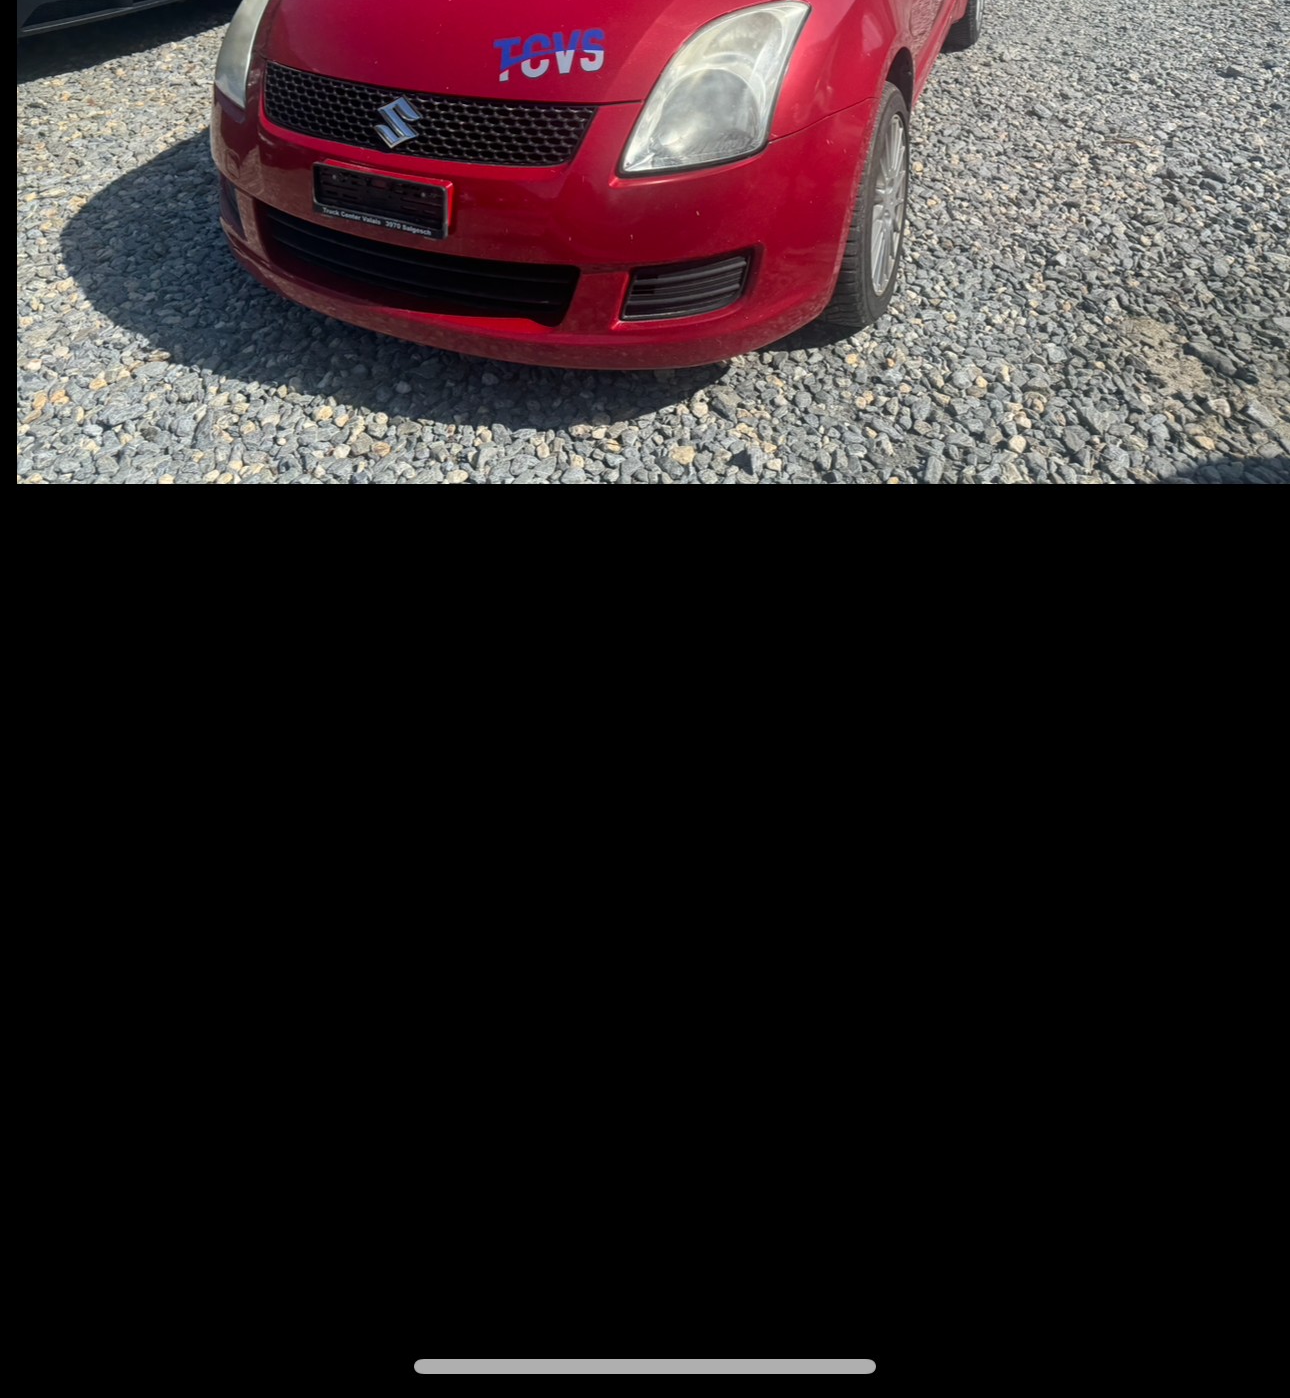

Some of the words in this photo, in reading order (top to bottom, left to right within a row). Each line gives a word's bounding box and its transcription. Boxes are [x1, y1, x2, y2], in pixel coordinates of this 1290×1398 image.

[493, 28, 605, 82] TCVS
[322, 207, 340, 216] Truck
[341, 211, 361, 221] Center
[362, 215, 382, 225] Valais
[402, 224, 432, 236] Salgesch
